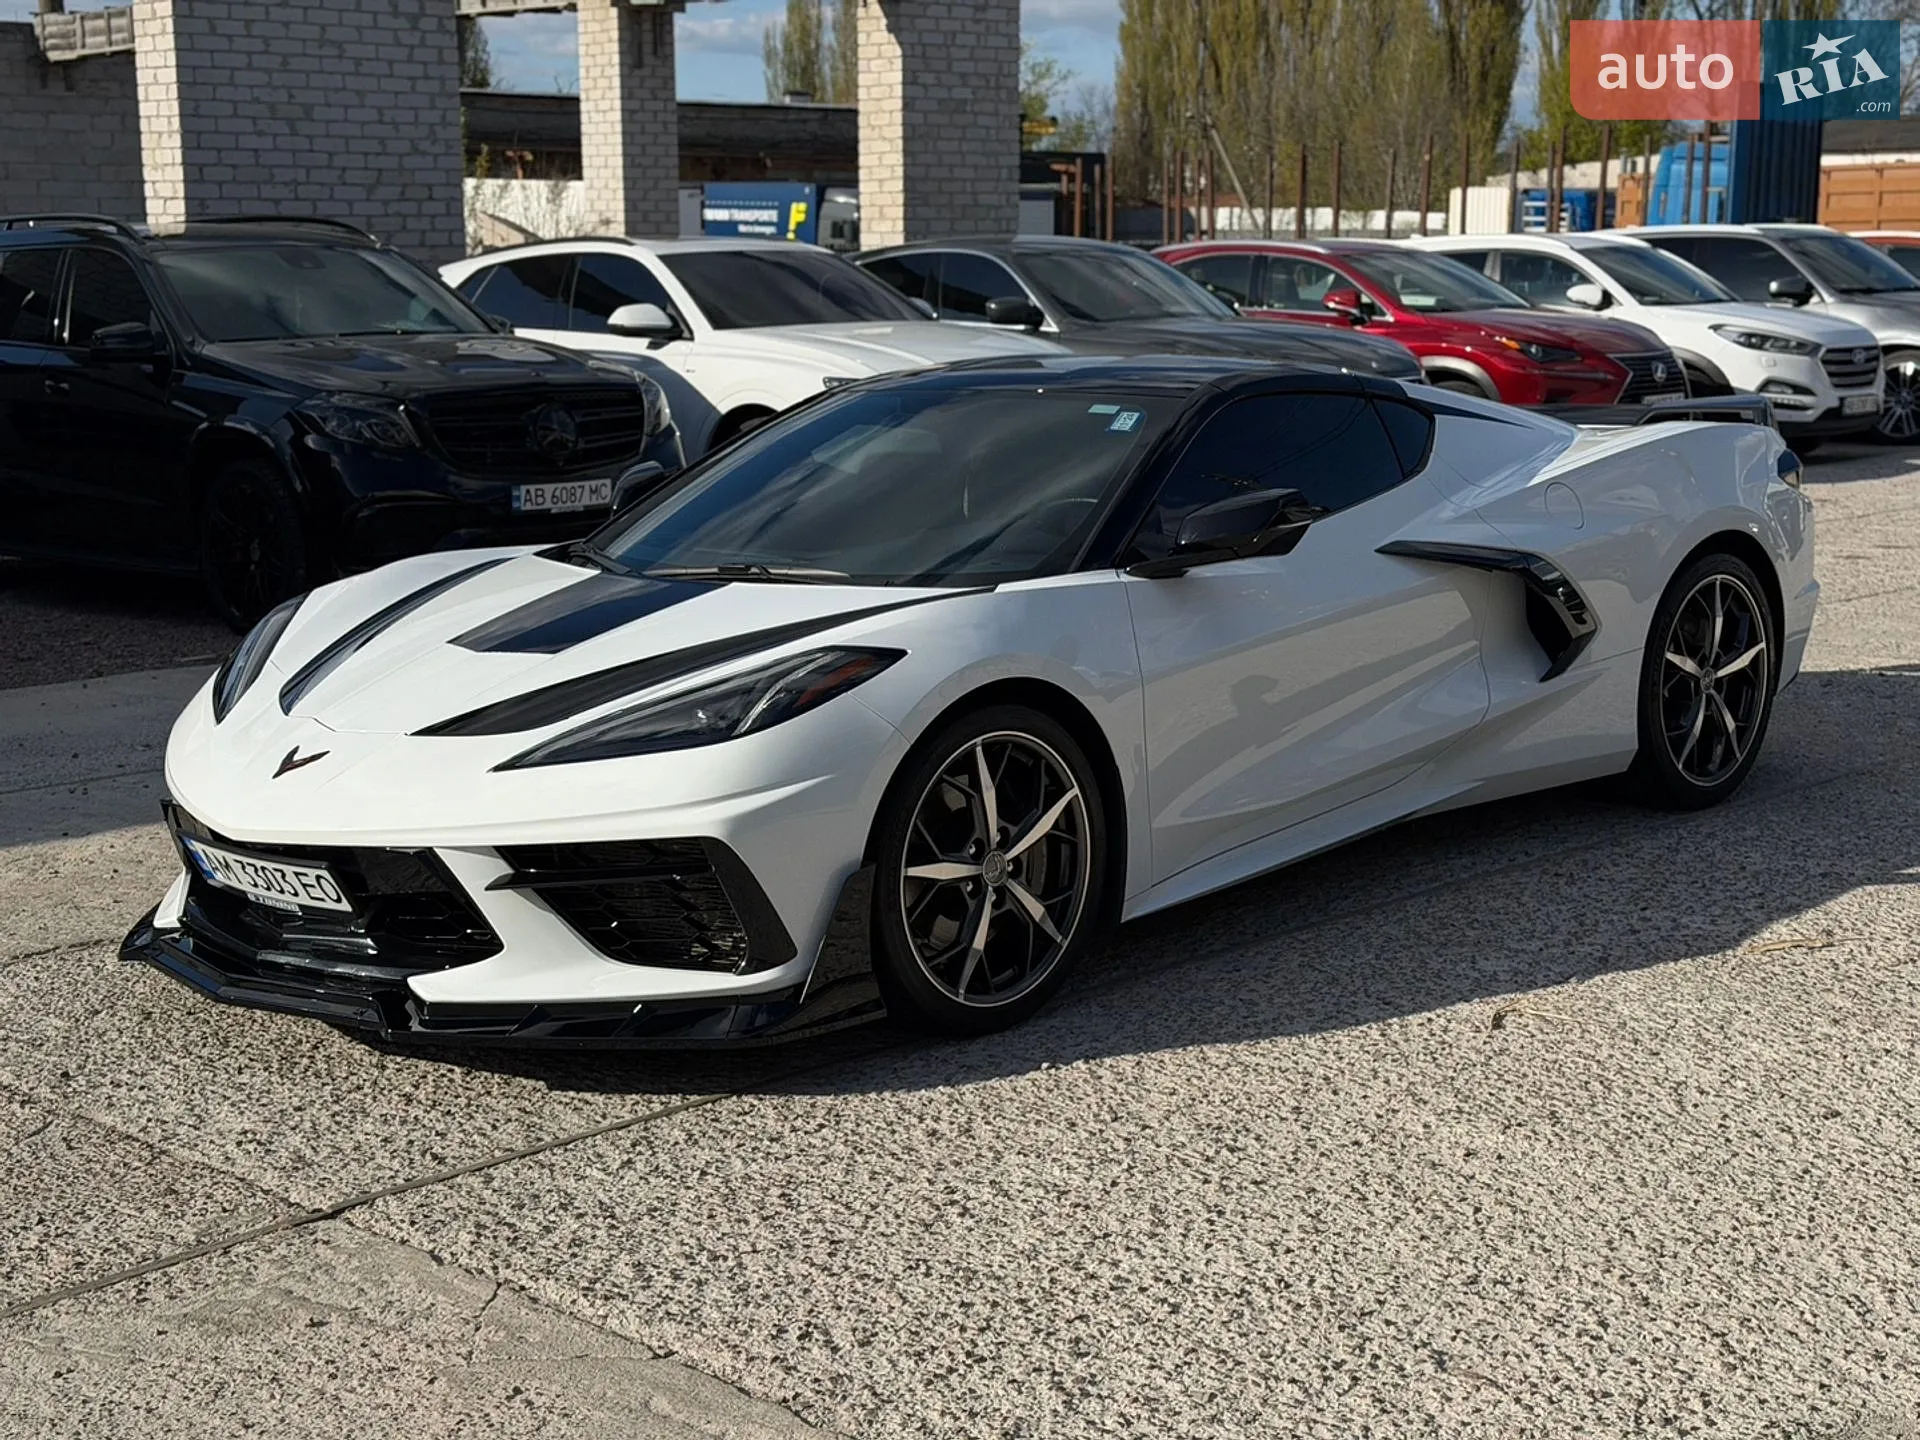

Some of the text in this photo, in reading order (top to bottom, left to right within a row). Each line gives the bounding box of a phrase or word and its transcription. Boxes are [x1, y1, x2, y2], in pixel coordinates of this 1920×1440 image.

[523, 483, 608, 506] AB 6087 MC
[201, 848, 242, 885] AM
[233, 859, 299, 897] 3303
[294, 871, 342, 904] EO
